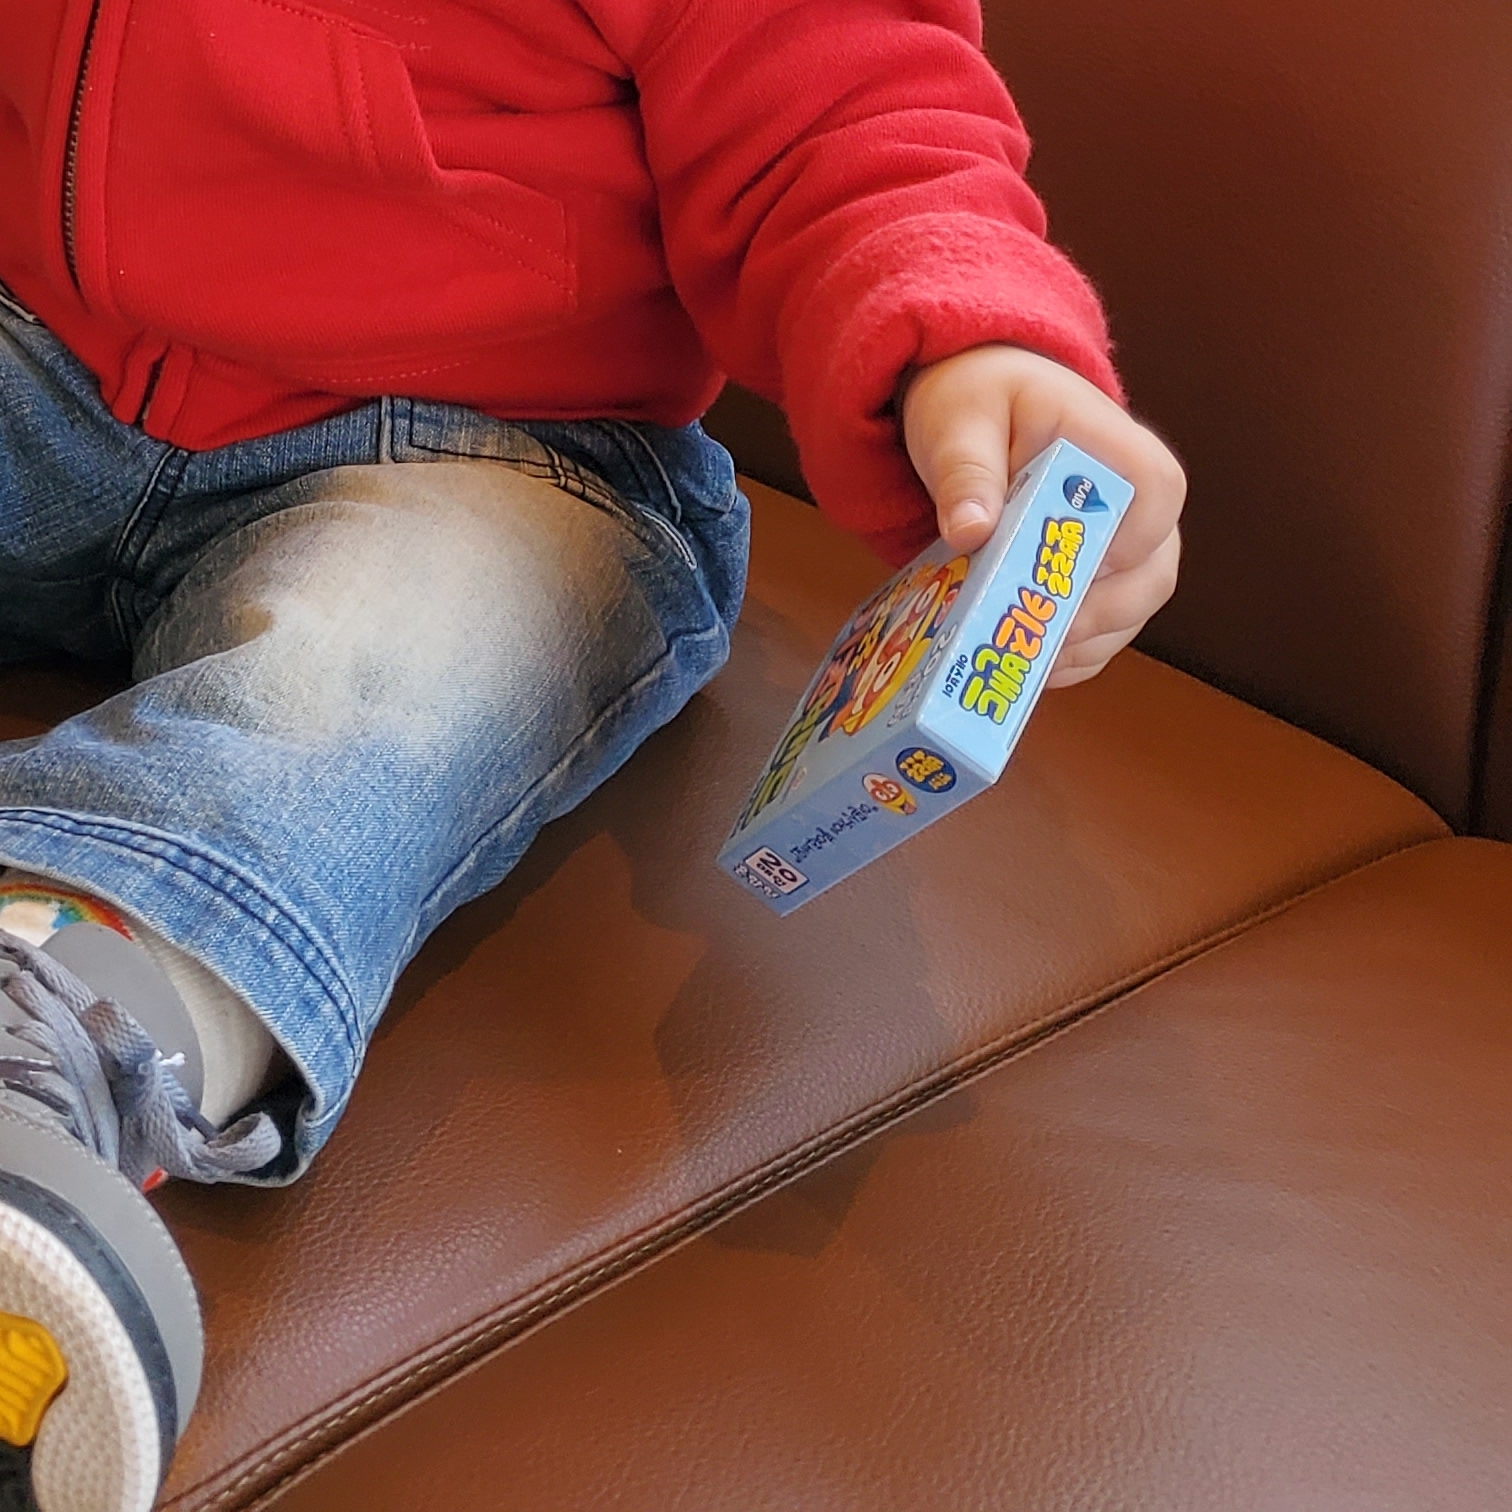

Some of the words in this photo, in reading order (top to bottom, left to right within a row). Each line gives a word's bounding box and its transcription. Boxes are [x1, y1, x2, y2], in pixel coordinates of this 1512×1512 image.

[1069, 478, 1093, 508] PLAID
[1032, 519, 1086, 600] 뽀로로
[940, 654, 969, 697] 에스브이
[958, 588, 1054, 725] 키즈밴드
[759, 852, 796, 883] 20
